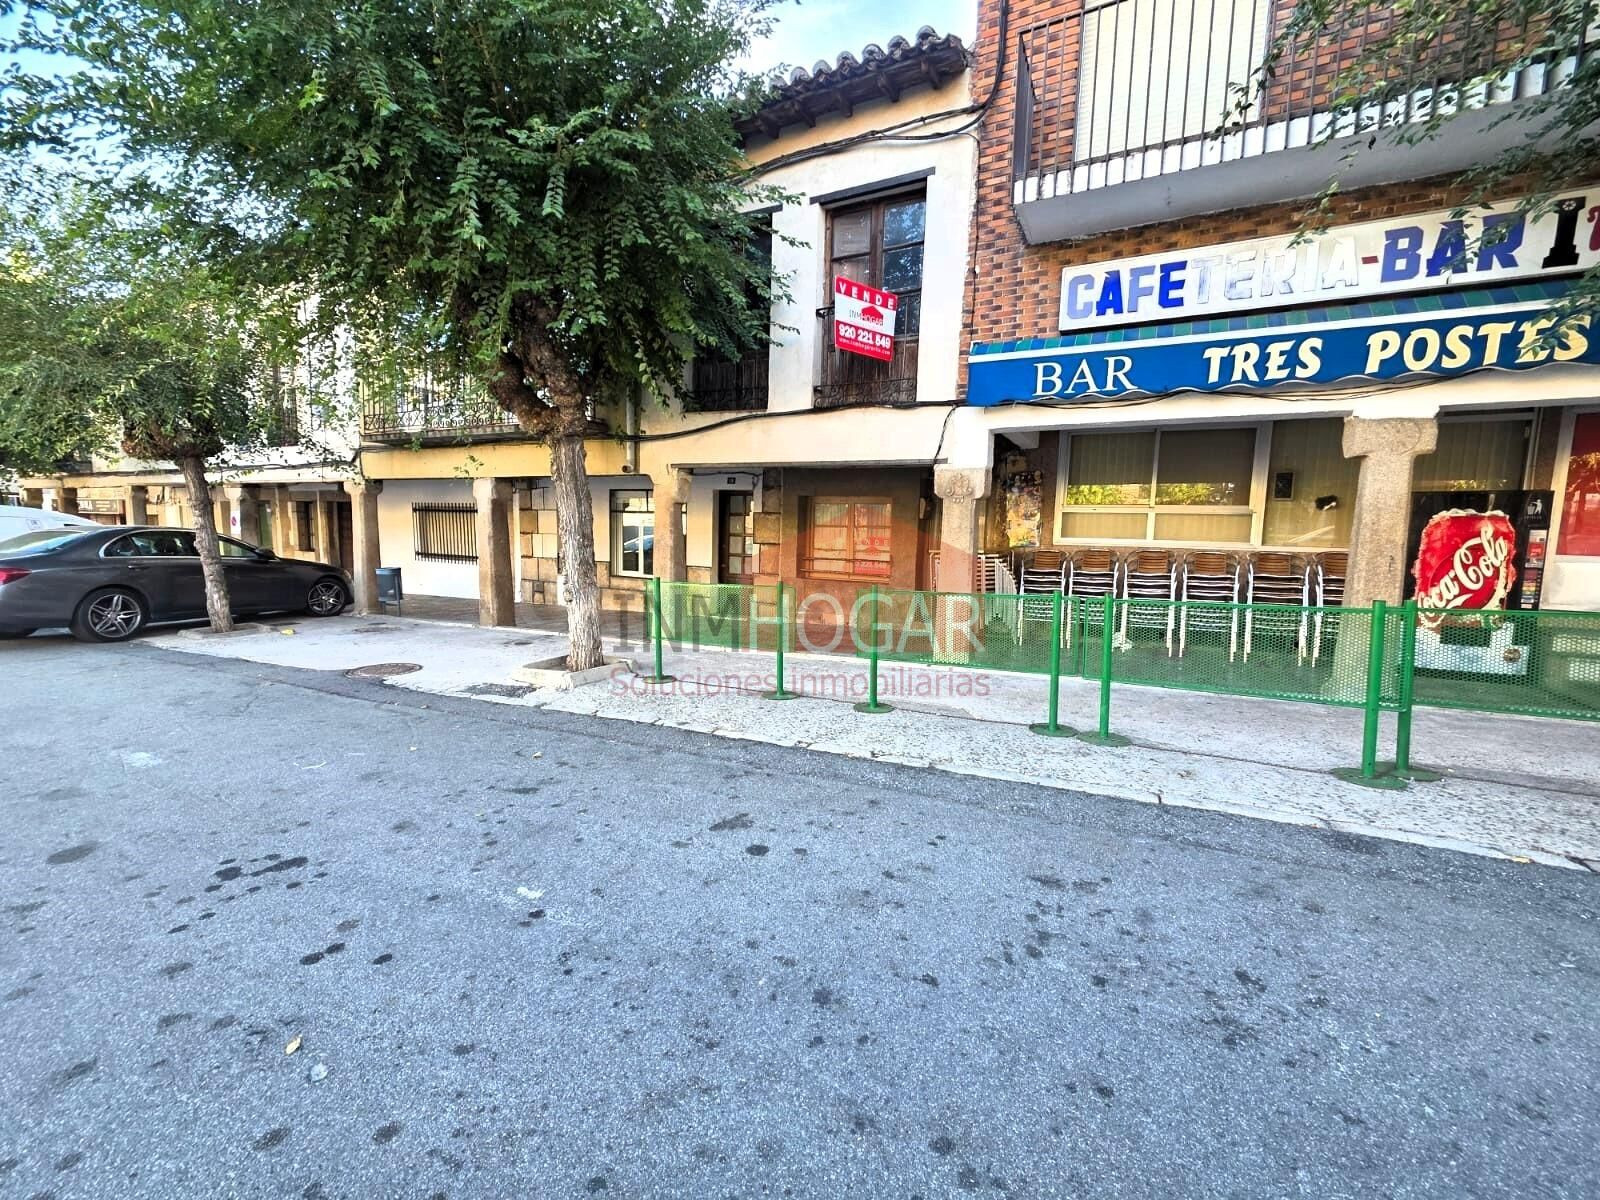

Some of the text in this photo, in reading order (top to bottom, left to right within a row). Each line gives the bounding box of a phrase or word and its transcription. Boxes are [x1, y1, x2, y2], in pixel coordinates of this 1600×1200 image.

[839, 282, 895, 309] VENDE
[838, 323, 856, 339] 920
[857, 329, 874, 344] 221
[1034, 315, 1591, 398] BAR TRES POSTES
